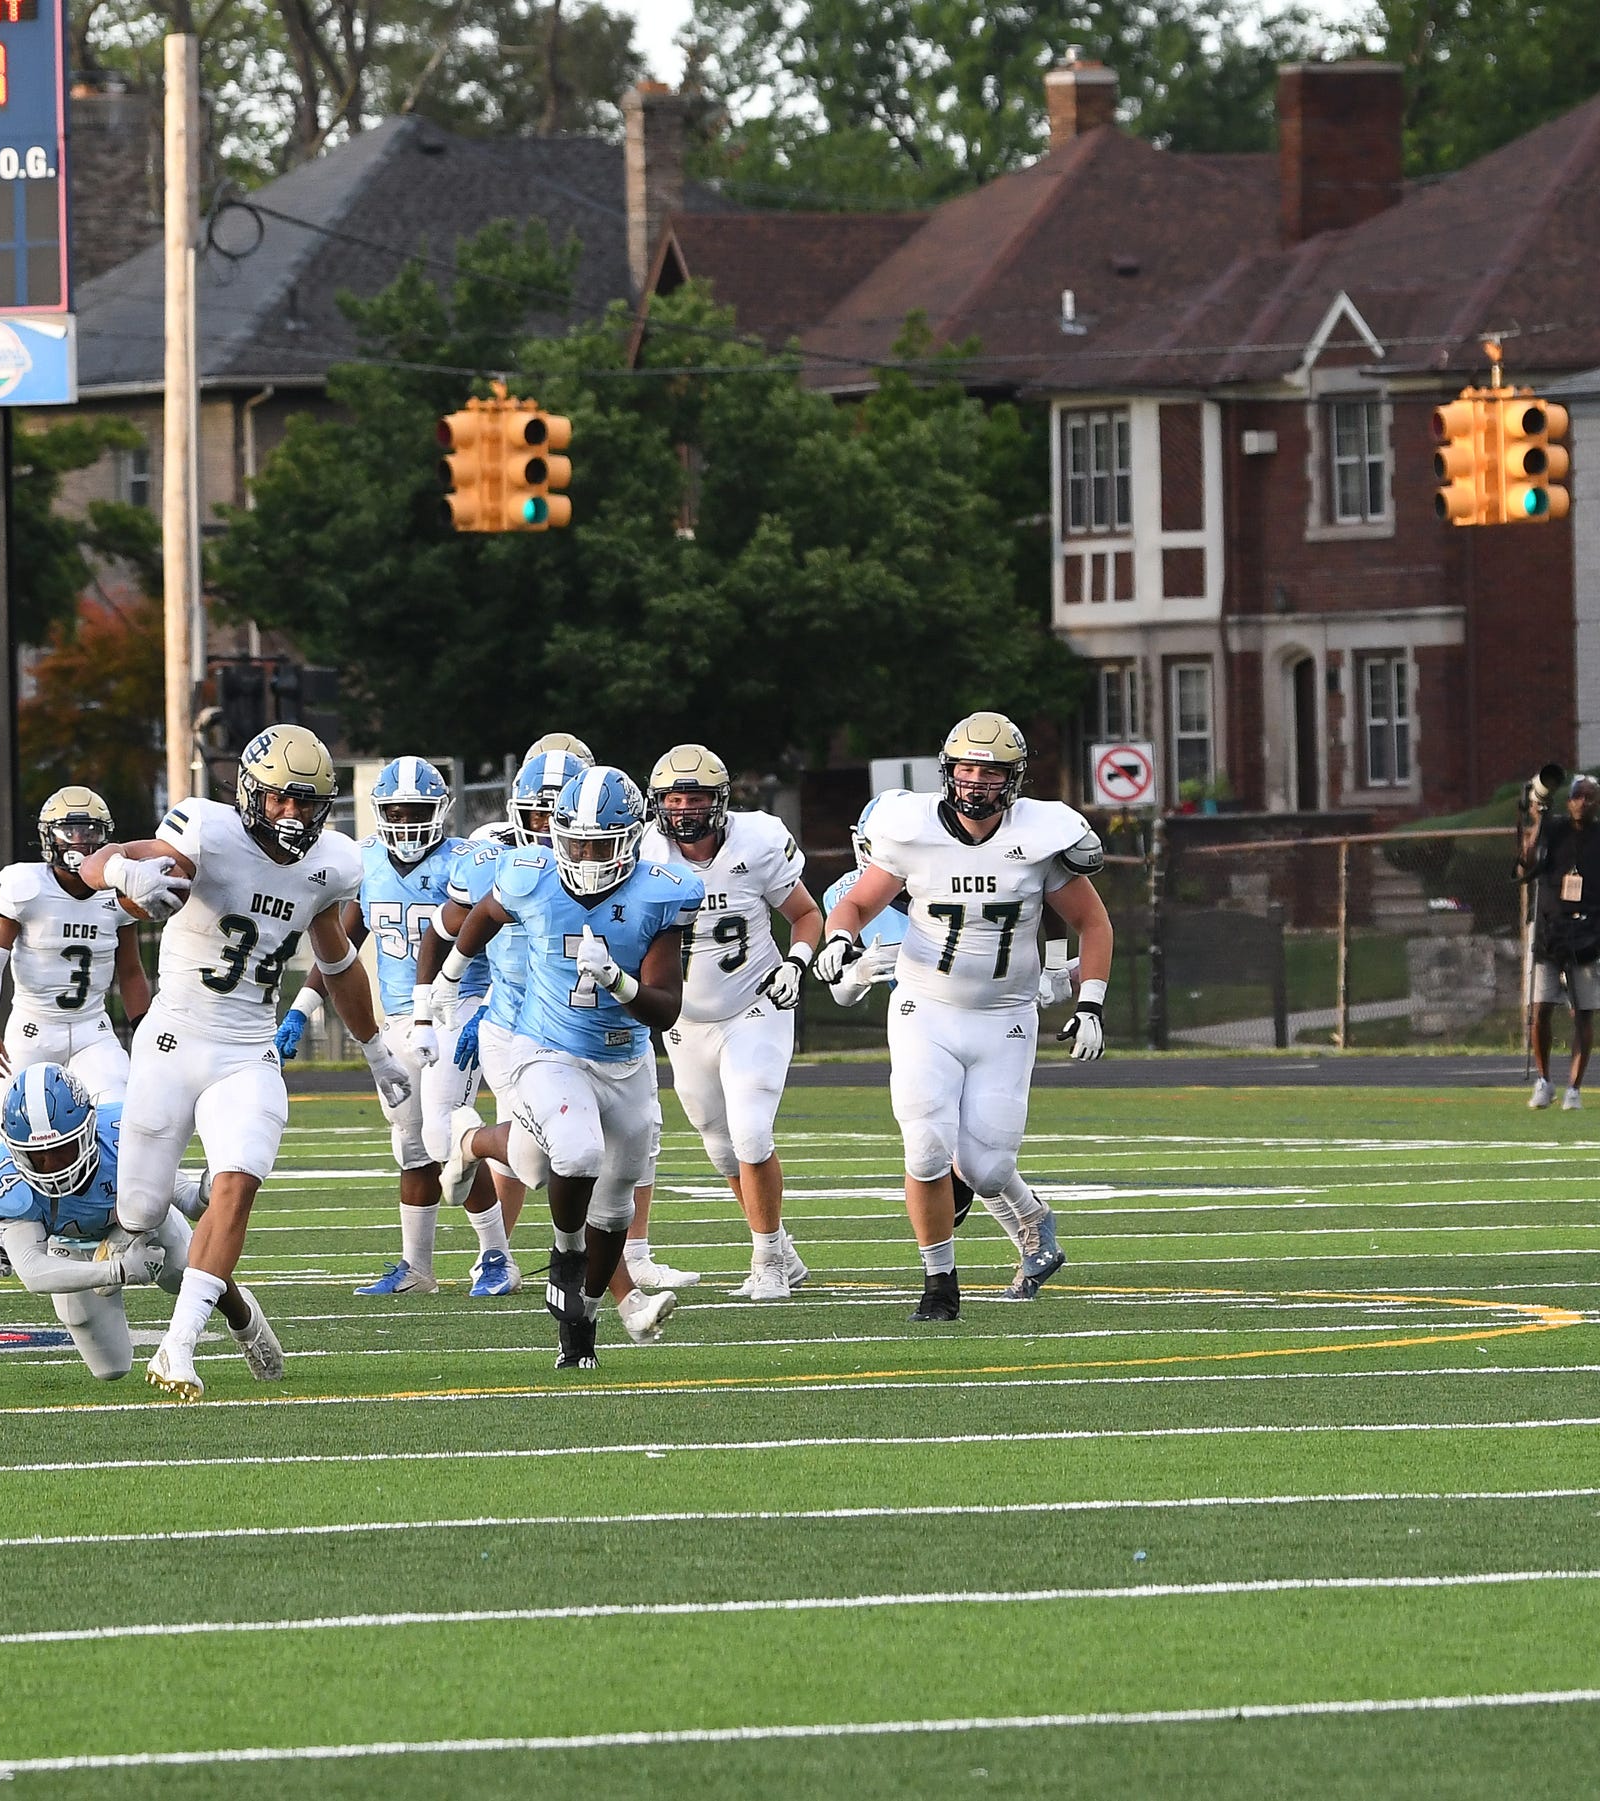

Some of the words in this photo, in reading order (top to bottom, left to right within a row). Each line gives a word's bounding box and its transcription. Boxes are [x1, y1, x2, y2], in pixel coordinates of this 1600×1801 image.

[951, 875, 997, 893] DCDS
[251, 893, 295, 921] DCDS
[63, 923, 98, 940] DCDS
[928, 901, 1024, 980] 77
[200, 913, 303, 1003] 34
[55, 944, 93, 1011] 3
[31, 1131, 57, 1142] Riddell
